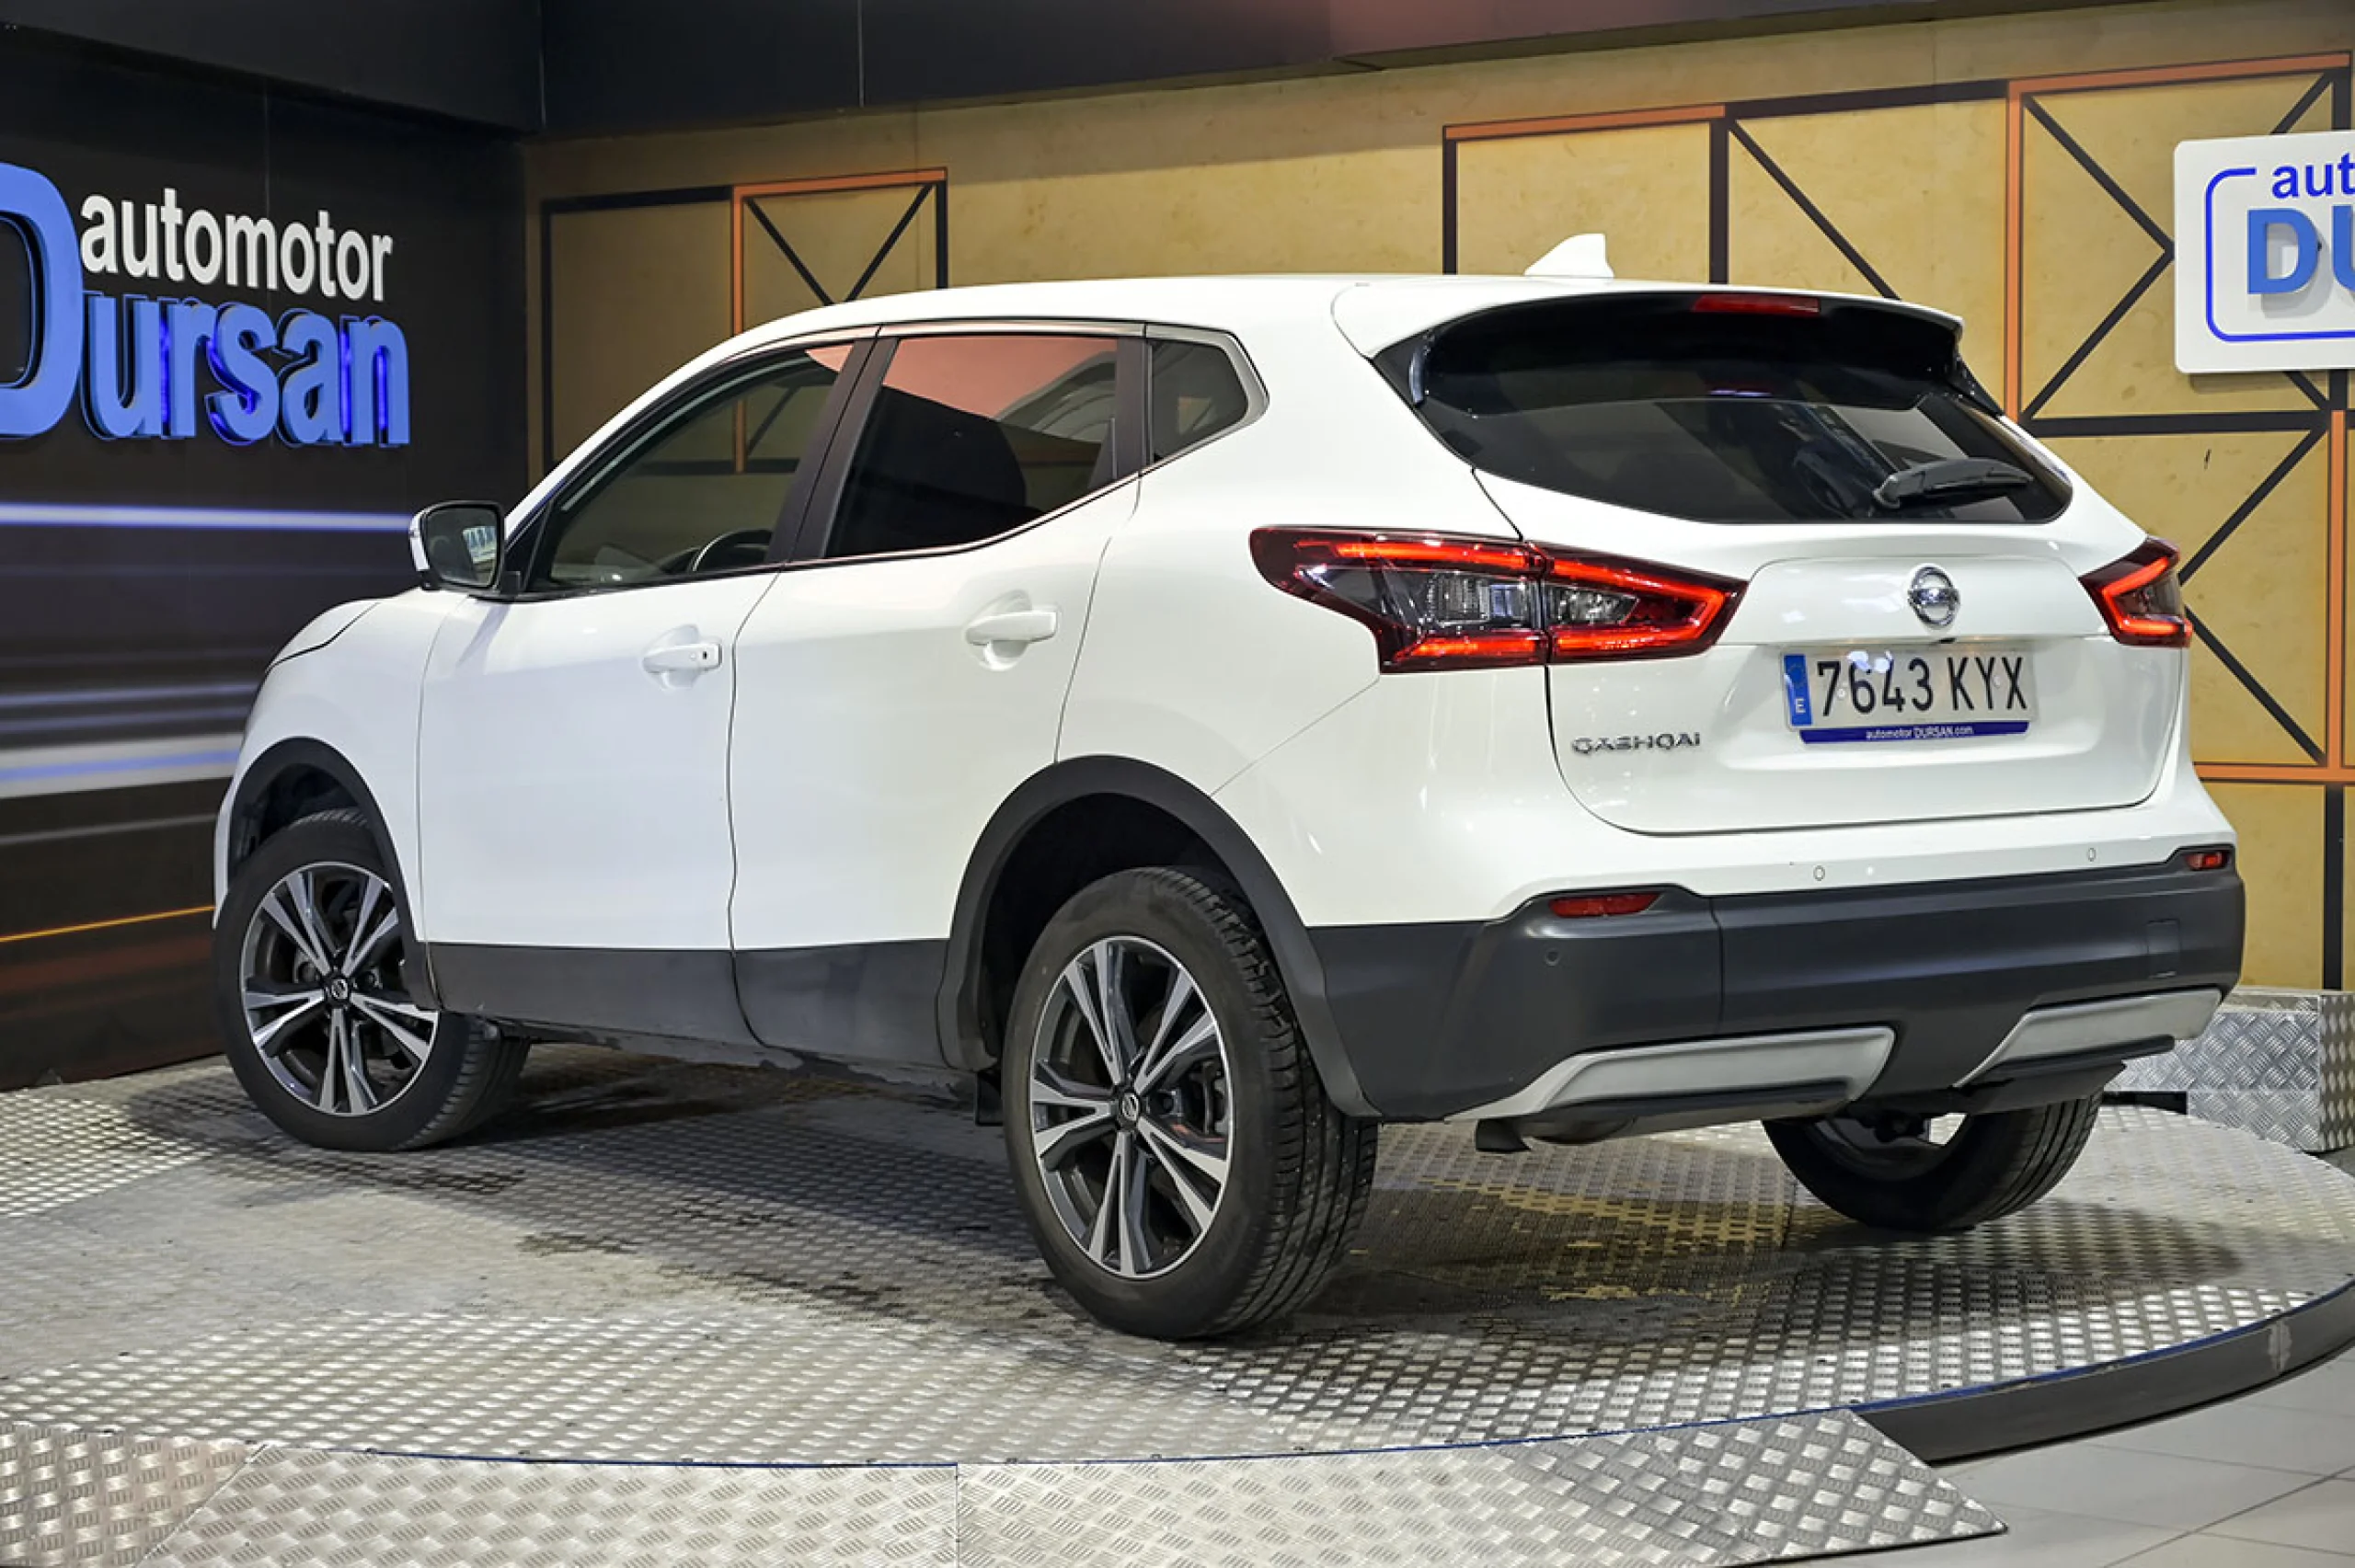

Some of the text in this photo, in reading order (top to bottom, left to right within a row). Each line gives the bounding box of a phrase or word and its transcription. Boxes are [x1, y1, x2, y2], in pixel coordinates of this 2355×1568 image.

[80, 188, 393, 302] automotor
[1795, 697, 1807, 715] E
[1817, 656, 2028, 717] 7643 KYX
[1571, 732, 1700, 754] QASHQAI
